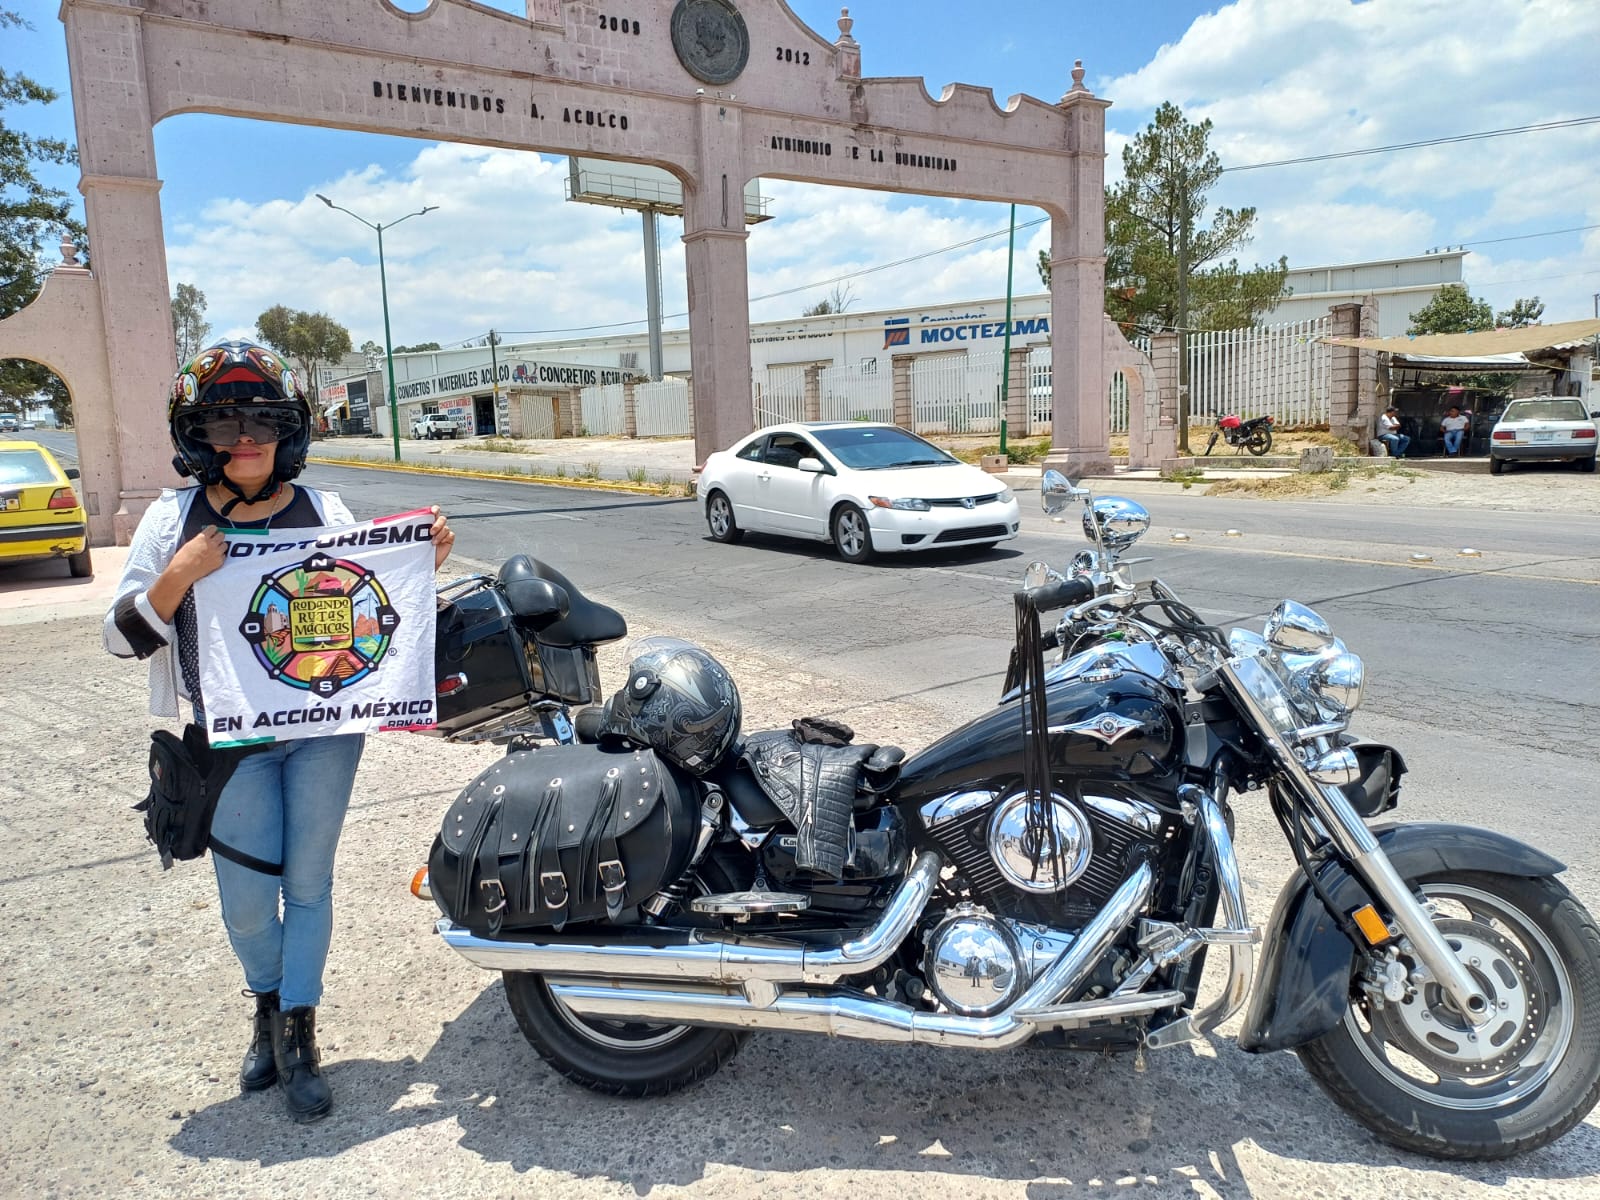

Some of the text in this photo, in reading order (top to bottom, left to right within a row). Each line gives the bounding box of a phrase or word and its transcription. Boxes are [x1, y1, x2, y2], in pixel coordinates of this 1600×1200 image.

[776, 47, 810, 66] 2012
[373, 81, 505, 114] BIENVENIDOS
[563, 107, 629, 131] ACULCO
[763, 135, 832, 157] ATRIMONIO
[870, 149, 884, 163] LA
[895, 152, 957, 172] HUMANIDAD
[398, 380, 431, 400] CONCRETOS
[432, 379, 436, 394] Y
[438, 370, 479, 392] MATERIALES
[539, 366, 597, 385] CONCRETOS
[311, 558, 328, 567] N
[382, 614, 395, 625] E
[319, 680, 333, 693] S
[212, 697, 433, 733] EN ACCIÓN MÉXICO
